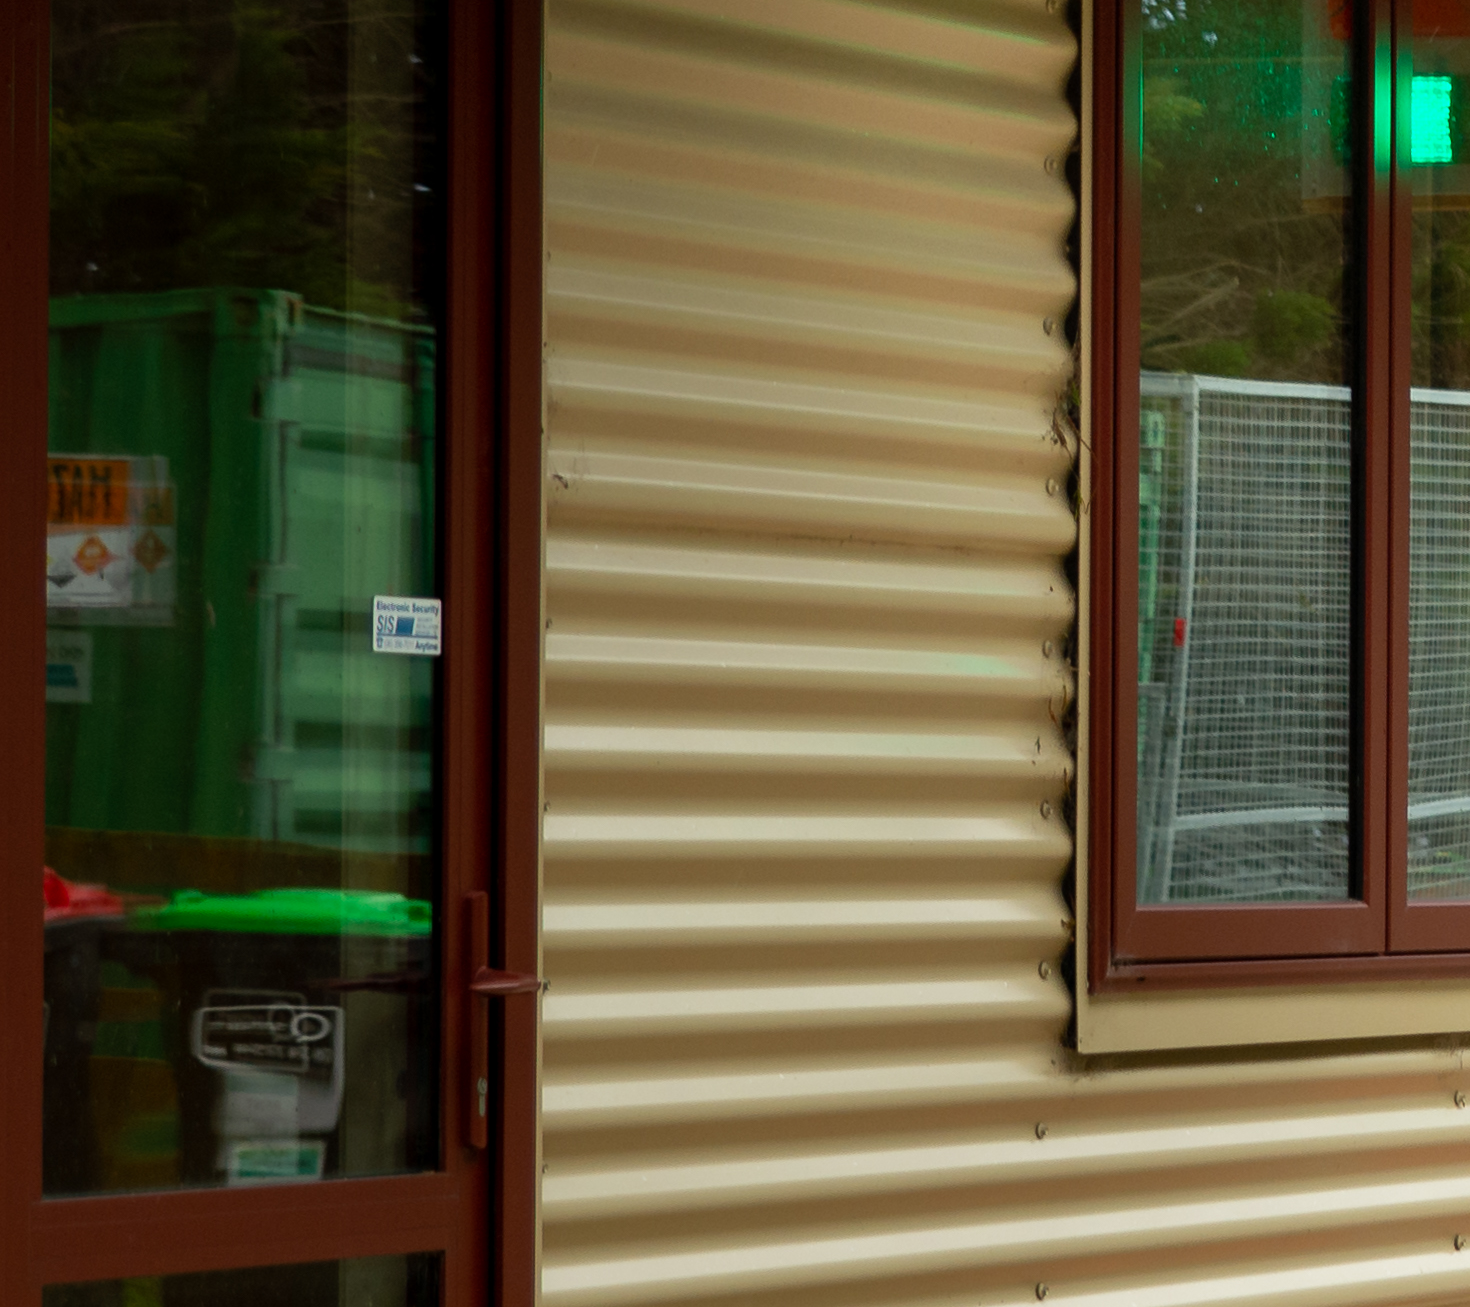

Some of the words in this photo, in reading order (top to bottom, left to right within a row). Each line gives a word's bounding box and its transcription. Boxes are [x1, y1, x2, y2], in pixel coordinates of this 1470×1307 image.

[377, 601, 410, 612] Electronic
[412, 603, 439, 617] Security
[377, 615, 395, 633] SIS
